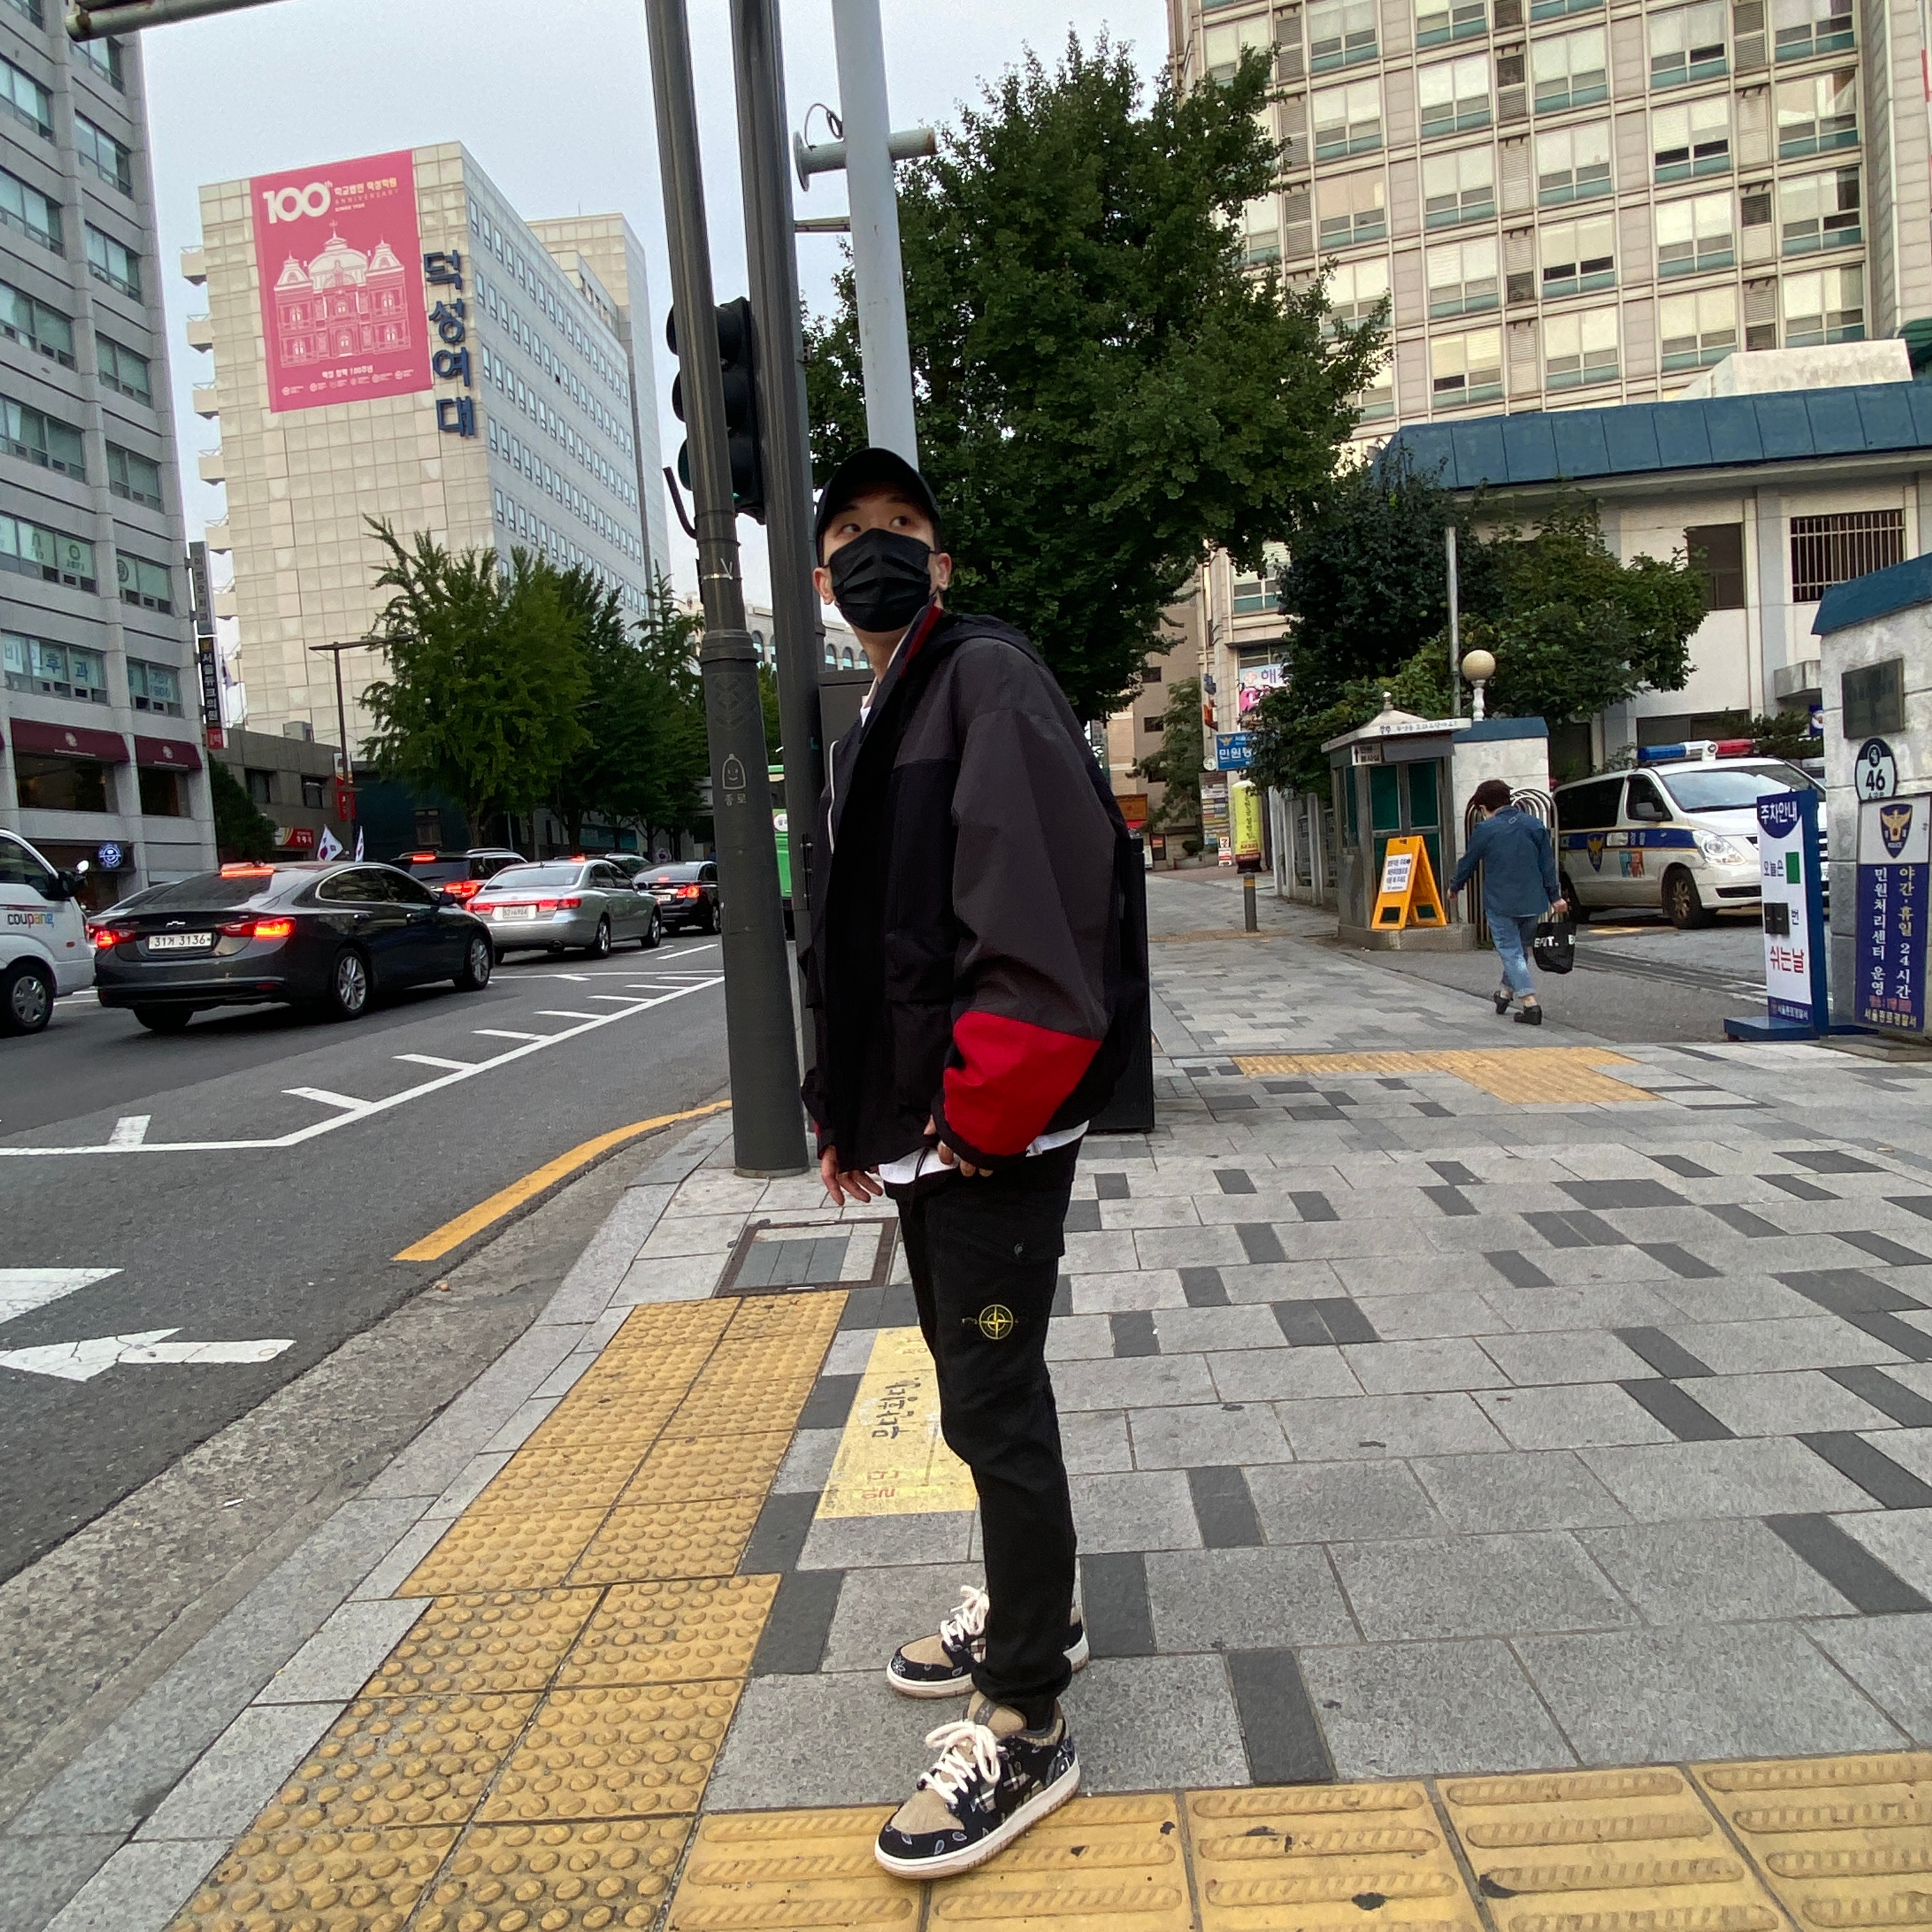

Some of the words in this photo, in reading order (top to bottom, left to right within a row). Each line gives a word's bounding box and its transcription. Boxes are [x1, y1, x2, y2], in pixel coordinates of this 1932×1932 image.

[424, 250, 475, 437] 덕성여대
[1866, 769, 1885, 791] 46
[724, 793, 747, 806] 종로
[1761, 801, 1797, 825] 주차안내
[1764, 860, 1784, 877] 오늘은
[8, 913, 54, 929] coupang
[1872, 867, 1887, 960] 민원처리센터
[179, 934, 205, 946] 3136
[1871, 966, 1885, 995] 운영
[1896, 943, 1912, 999] 24시간
